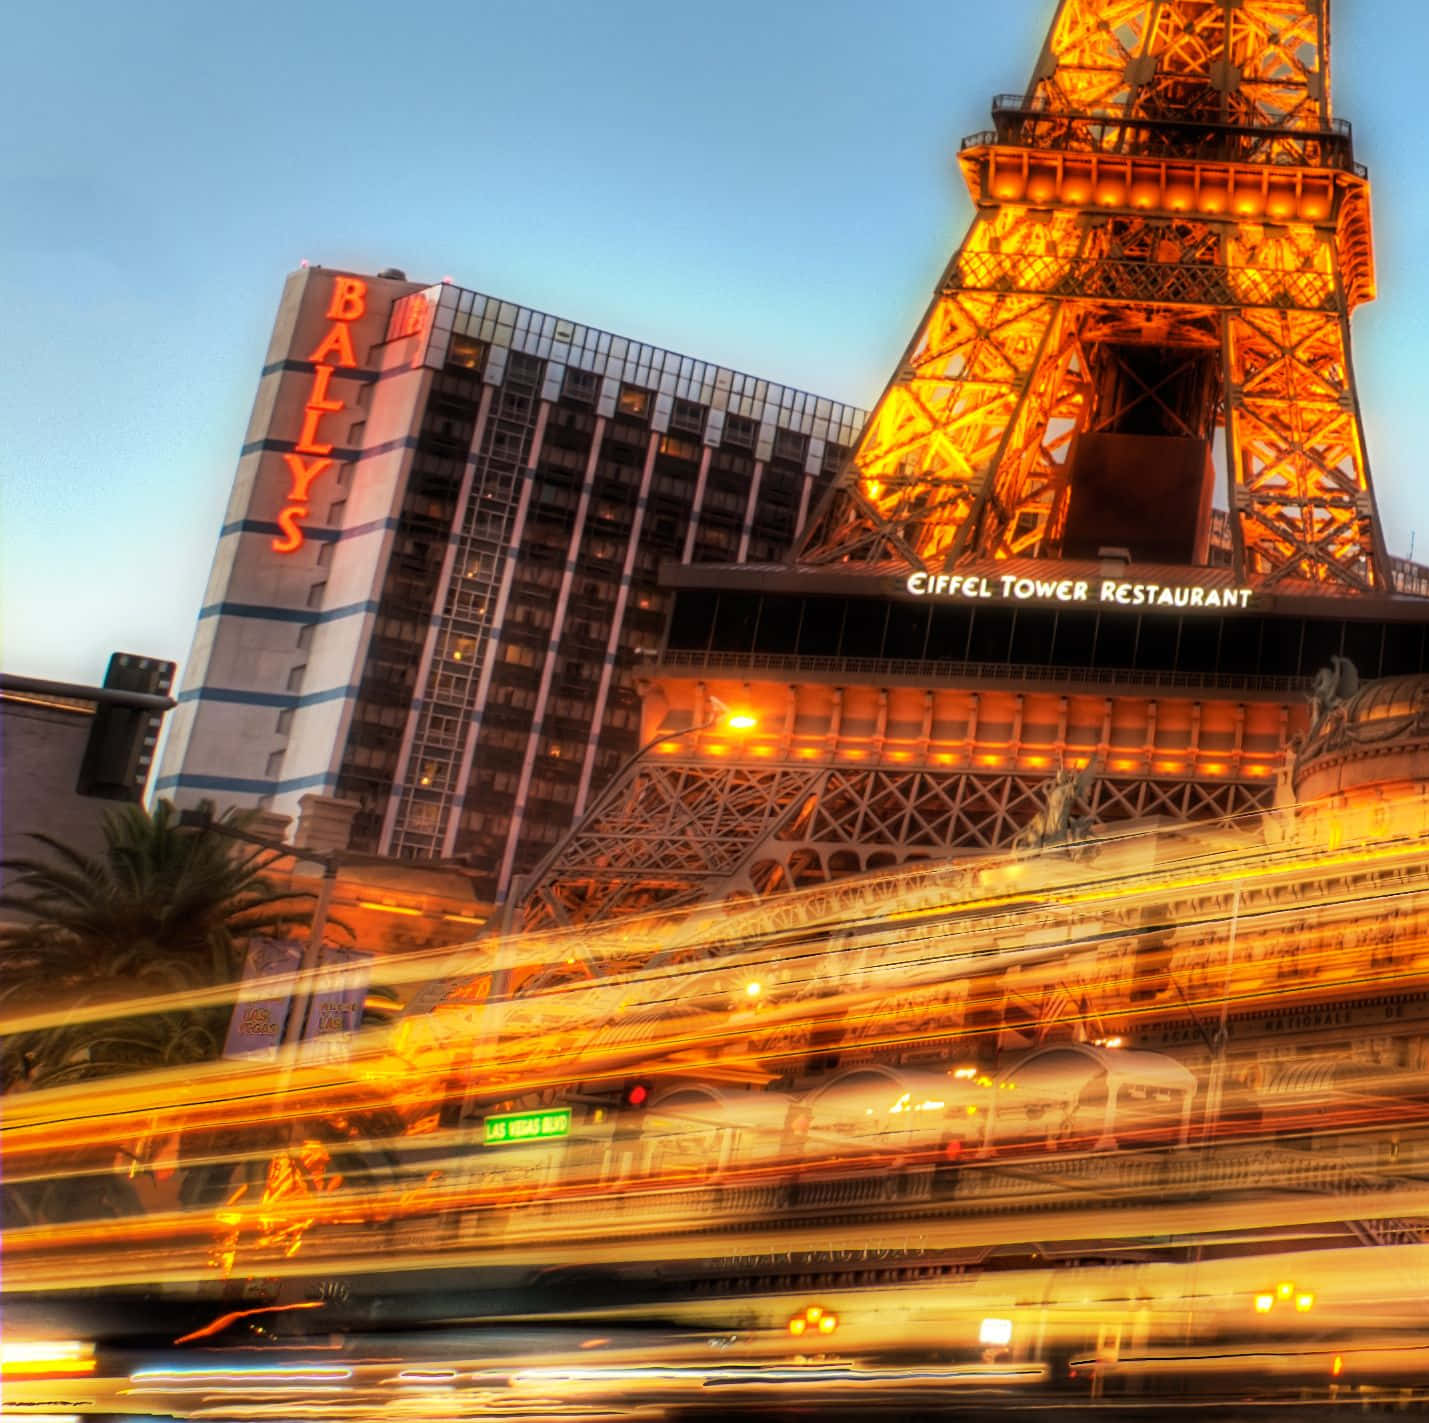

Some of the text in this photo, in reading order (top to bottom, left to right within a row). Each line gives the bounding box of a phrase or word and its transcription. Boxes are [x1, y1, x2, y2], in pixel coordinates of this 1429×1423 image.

[271, 275, 368, 554] BALLYS
[1000, 575, 1089, 602] TOWER
[1099, 580, 1253, 609] RESTAURANT
[487, 1115, 567, 1139] LAS VEGAS BLVD
